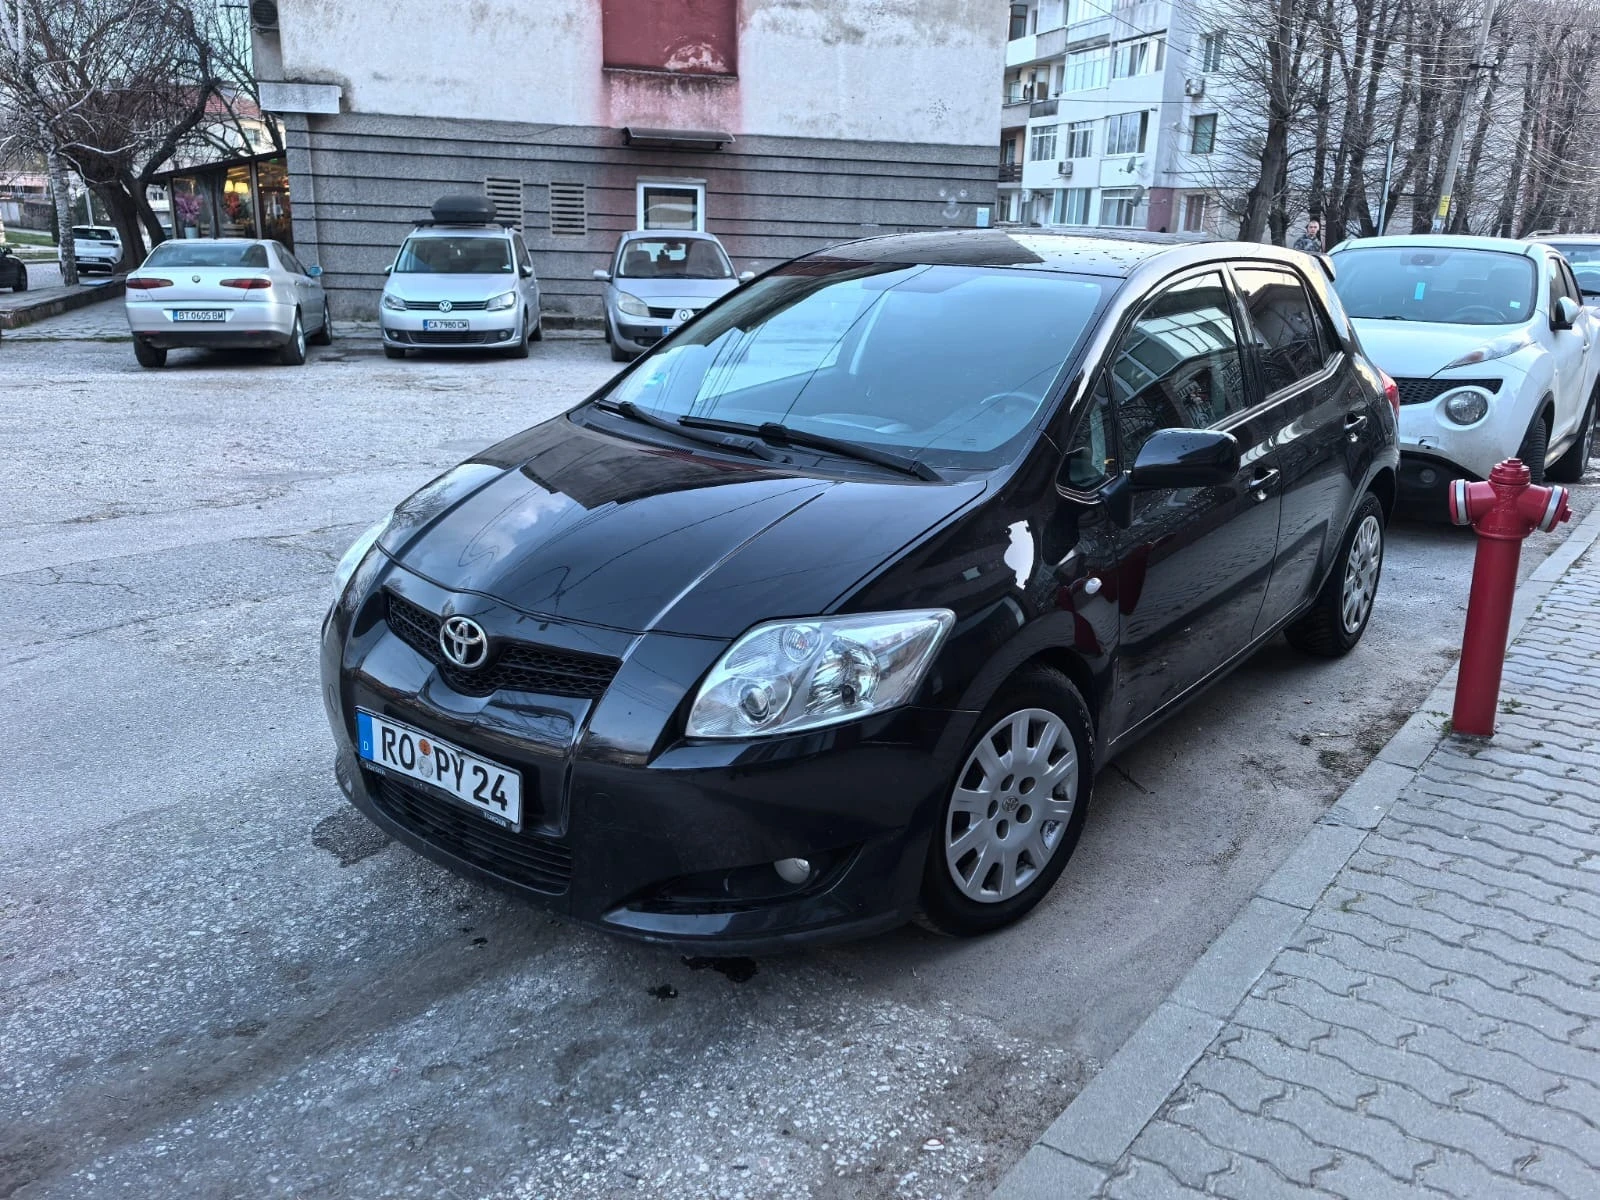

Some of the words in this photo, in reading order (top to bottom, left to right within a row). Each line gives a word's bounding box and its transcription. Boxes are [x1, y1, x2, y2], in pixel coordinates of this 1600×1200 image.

[178, 311, 189, 320] BT
[191, 311, 211, 320] 0605
[212, 311, 224, 320] BM
[363, 740, 369, 751] D
[381, 725, 416, 771] RO
[433, 745, 465, 792] PY
[472, 765, 508, 812] 24
